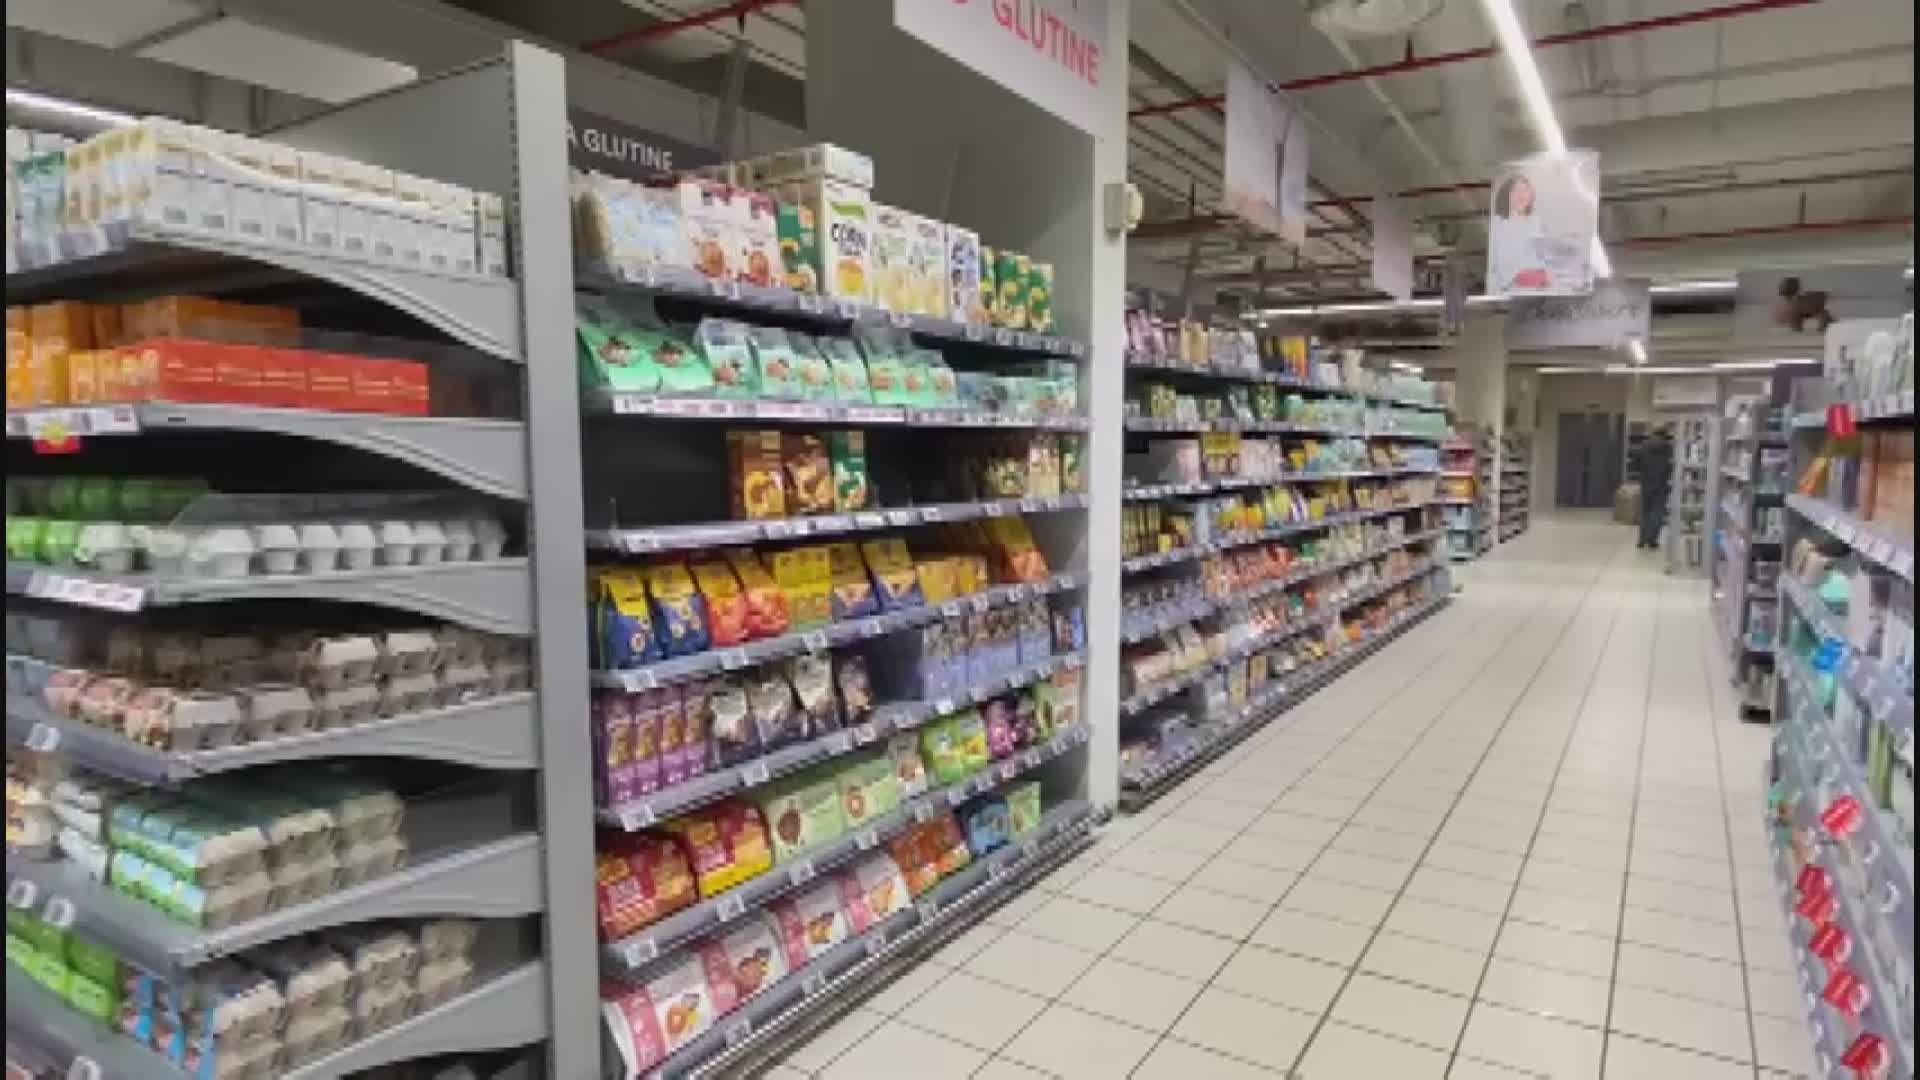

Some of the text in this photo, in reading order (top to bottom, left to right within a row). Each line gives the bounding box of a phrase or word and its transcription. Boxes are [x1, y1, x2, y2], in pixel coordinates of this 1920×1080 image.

[992, 0, 1100, 87] GLUTINE
[583, 129, 673, 171] GLUTINE
[831, 223, 867, 252] CORN
